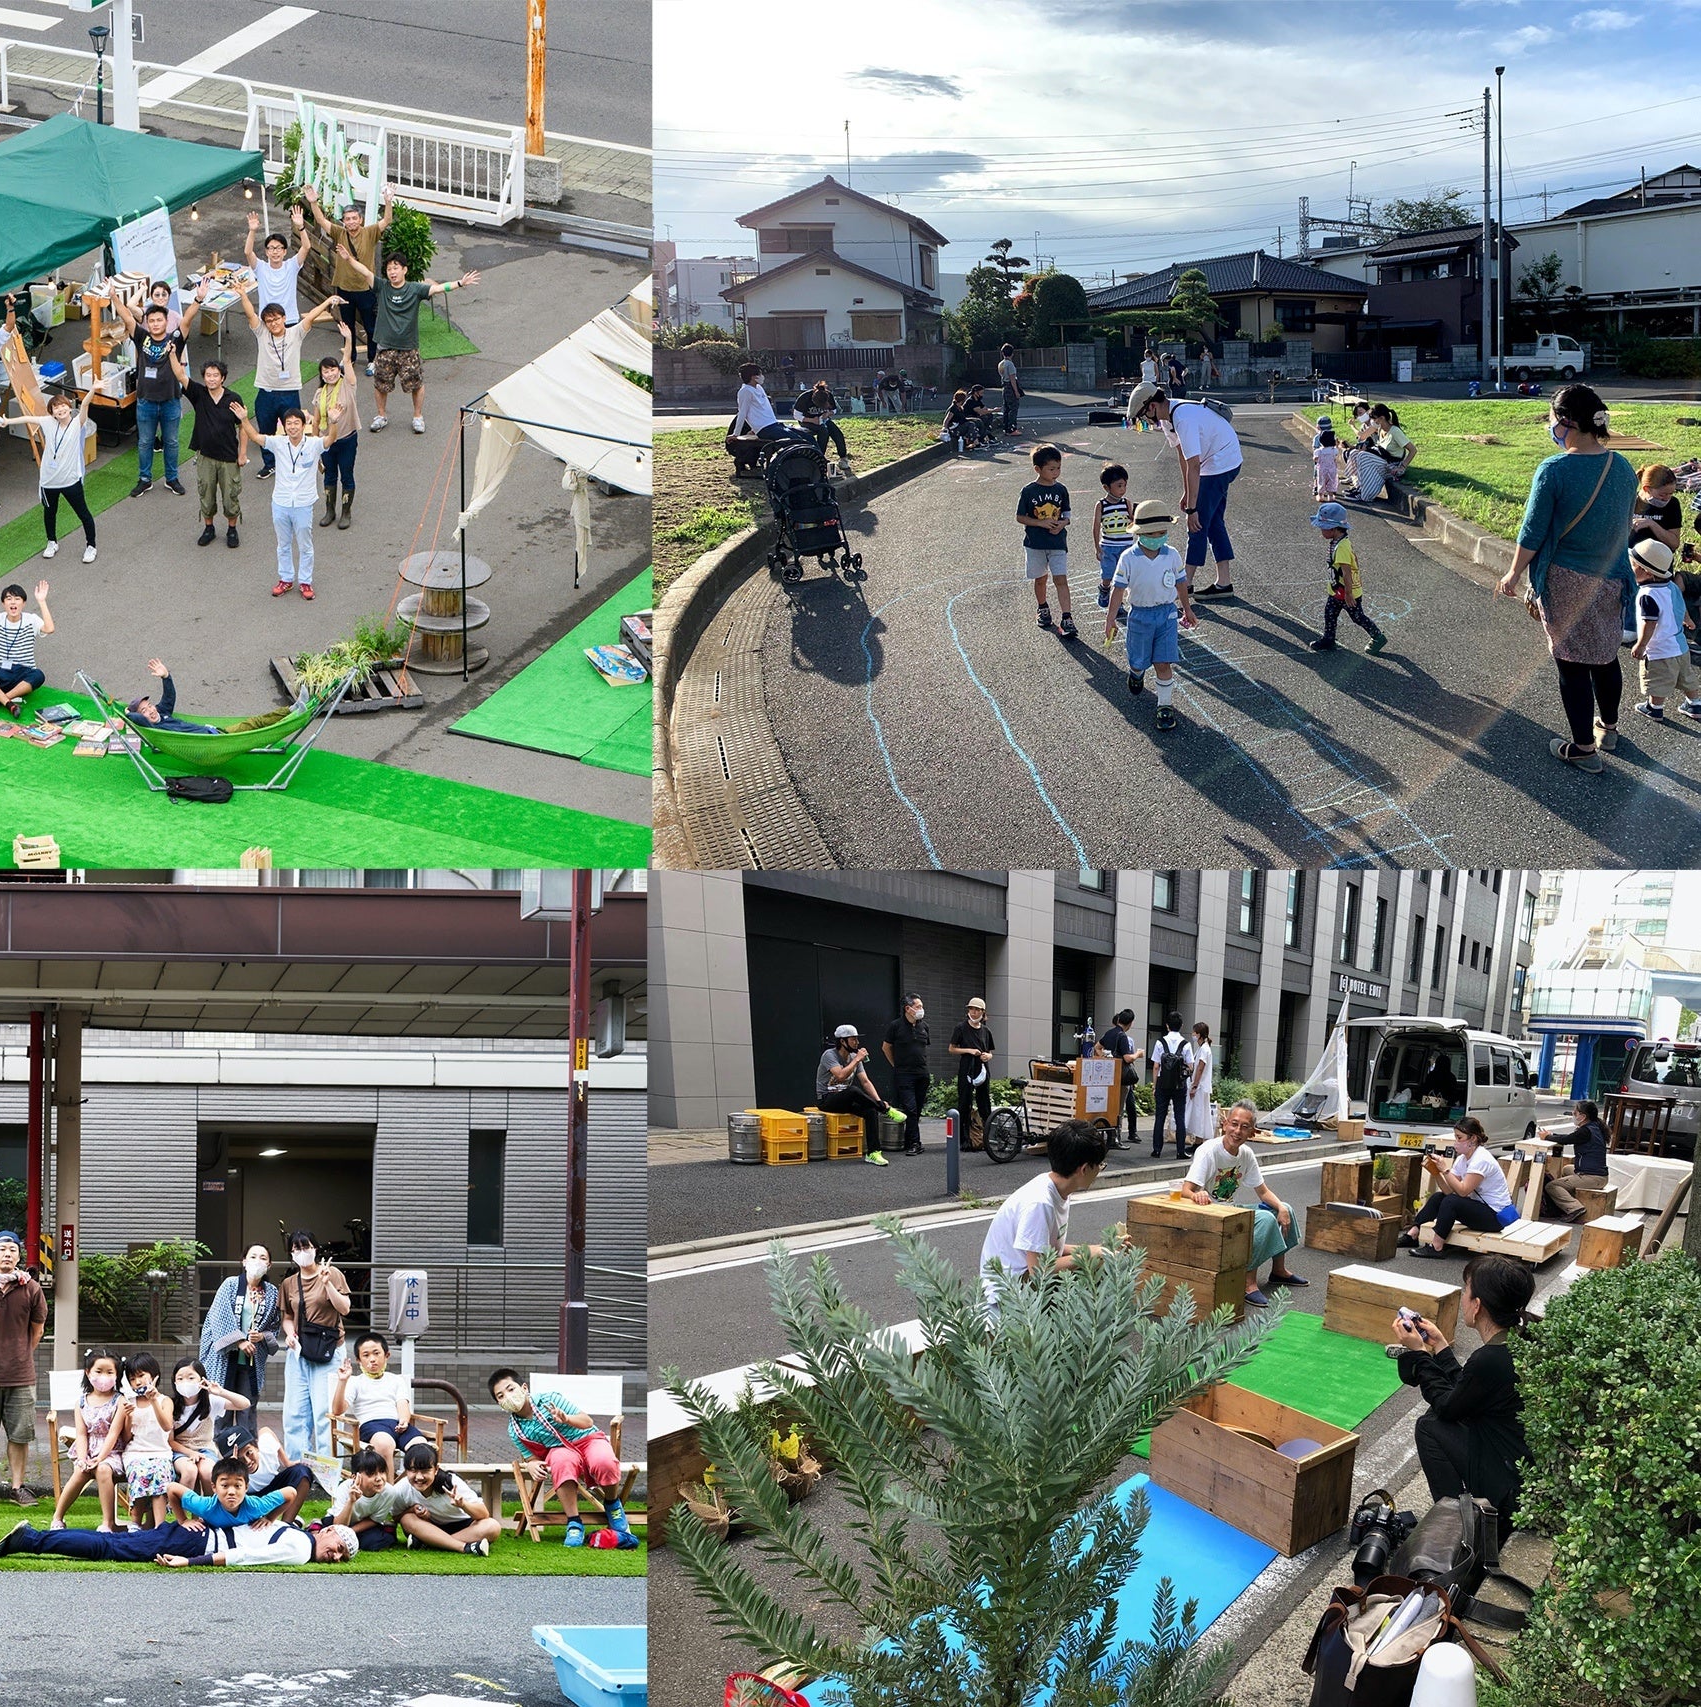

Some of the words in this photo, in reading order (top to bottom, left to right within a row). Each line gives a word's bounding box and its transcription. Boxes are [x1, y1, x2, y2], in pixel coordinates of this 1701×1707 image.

[63, 1229, 72, 1256] 送水口
[405, 1276, 419, 1320] 休止中
